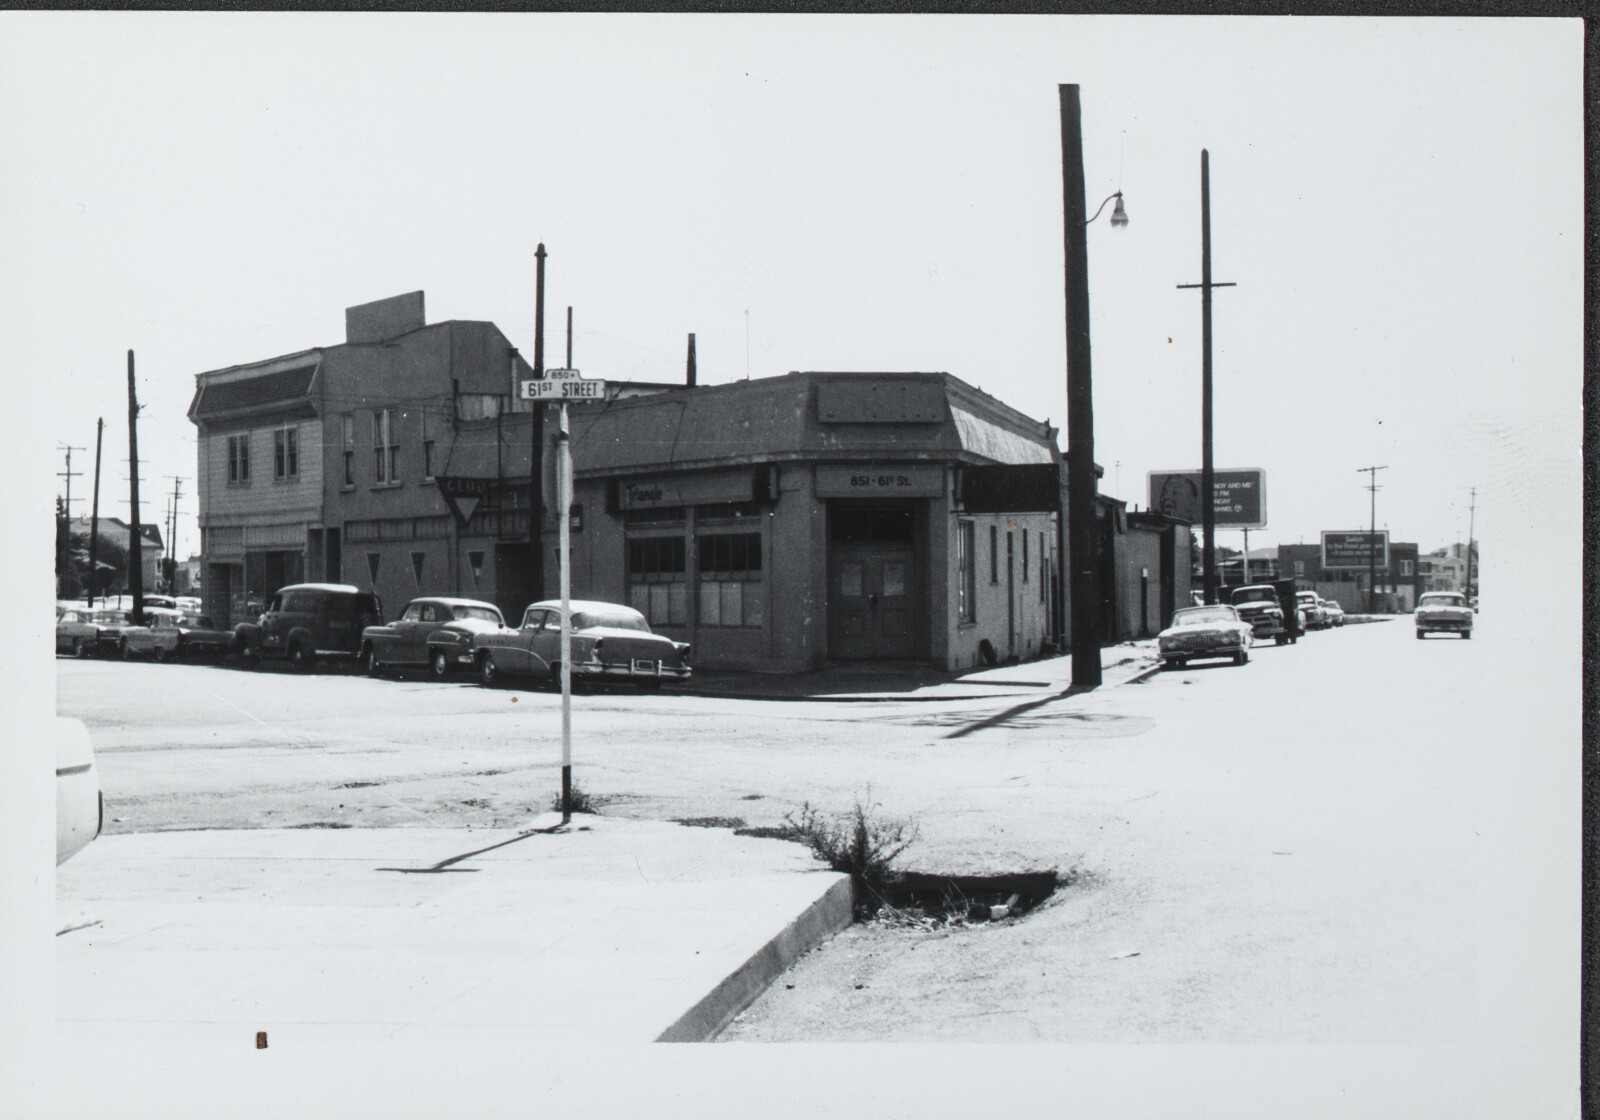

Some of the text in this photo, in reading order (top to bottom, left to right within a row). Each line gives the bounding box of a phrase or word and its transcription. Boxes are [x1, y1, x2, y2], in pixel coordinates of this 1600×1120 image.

[528, 382, 597, 397] 61ST STREET
[626, 483, 663, 506] Triangle
